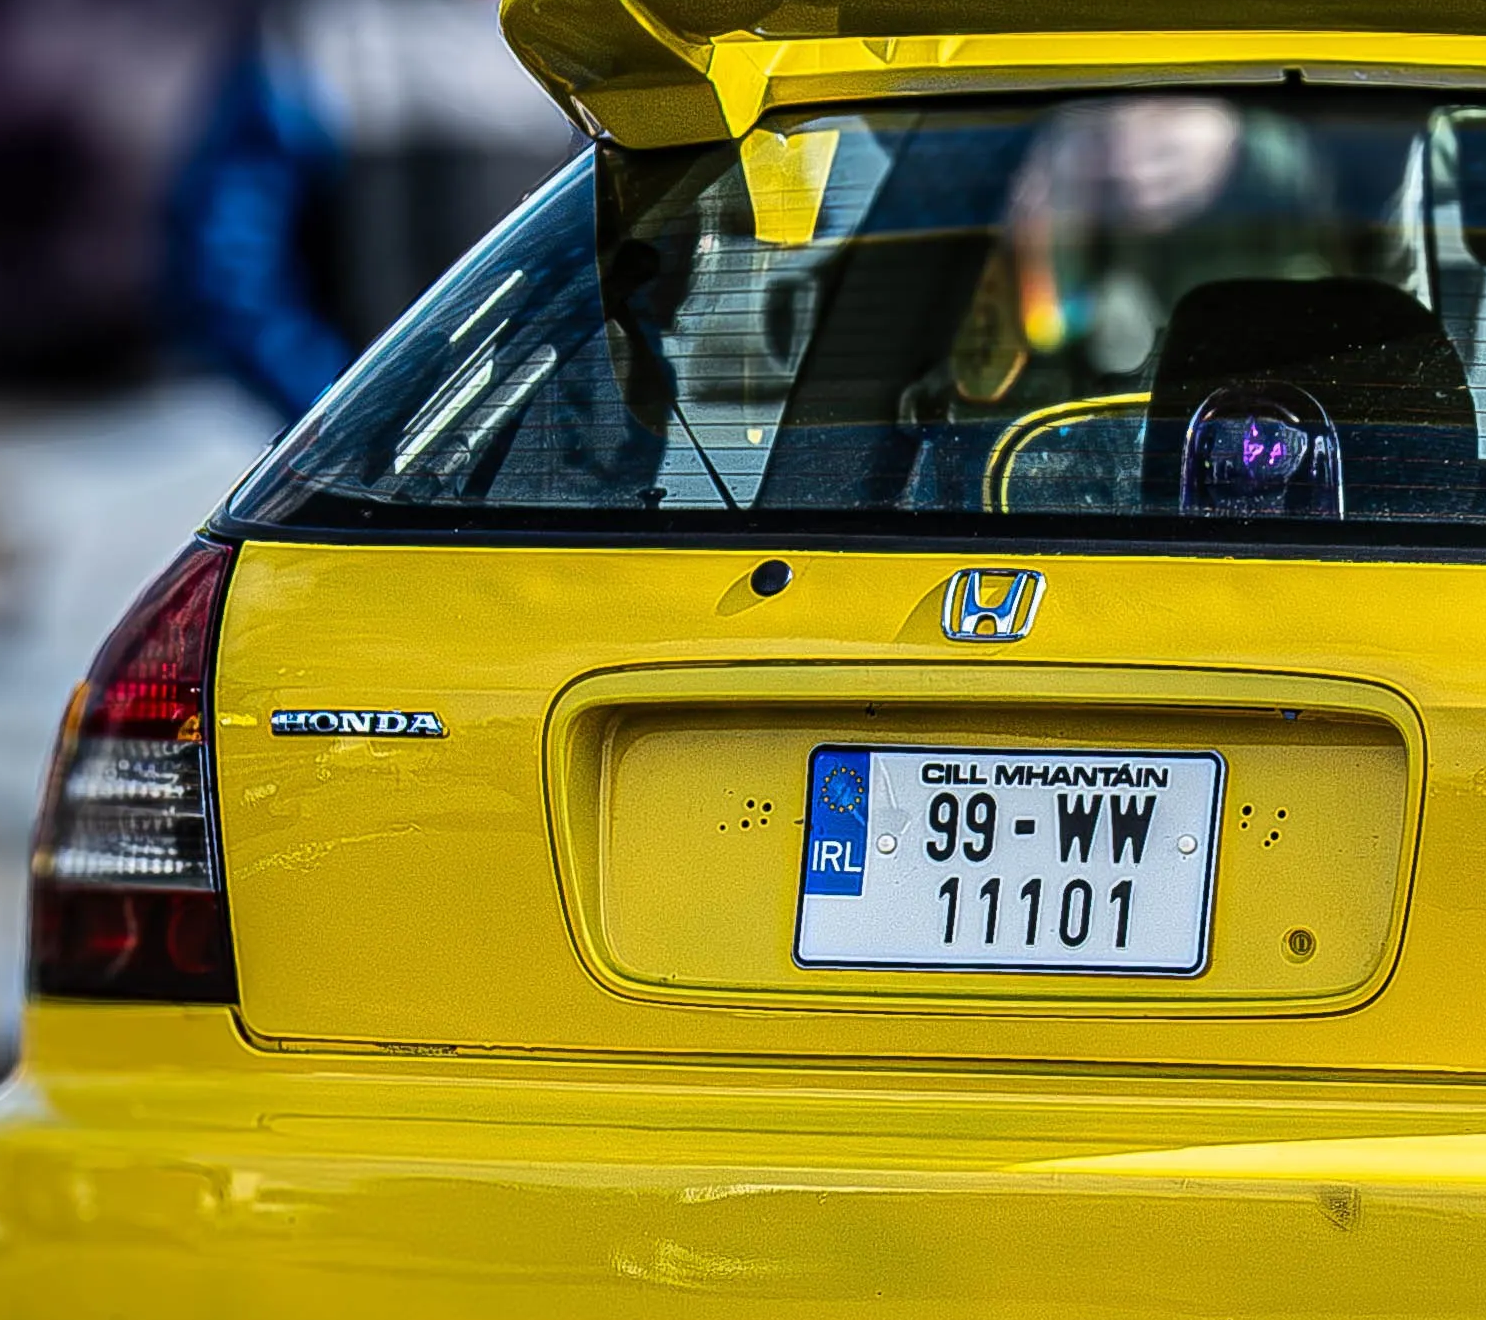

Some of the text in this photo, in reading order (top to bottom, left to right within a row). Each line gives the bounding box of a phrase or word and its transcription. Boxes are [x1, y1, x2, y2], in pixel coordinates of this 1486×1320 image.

[271, 712, 443, 735] HONDA
[921, 762, 1168, 789] CILL MHANTÁIN
[812, 840, 862, 874] IRL
[938, 877, 1134, 948] 11101
